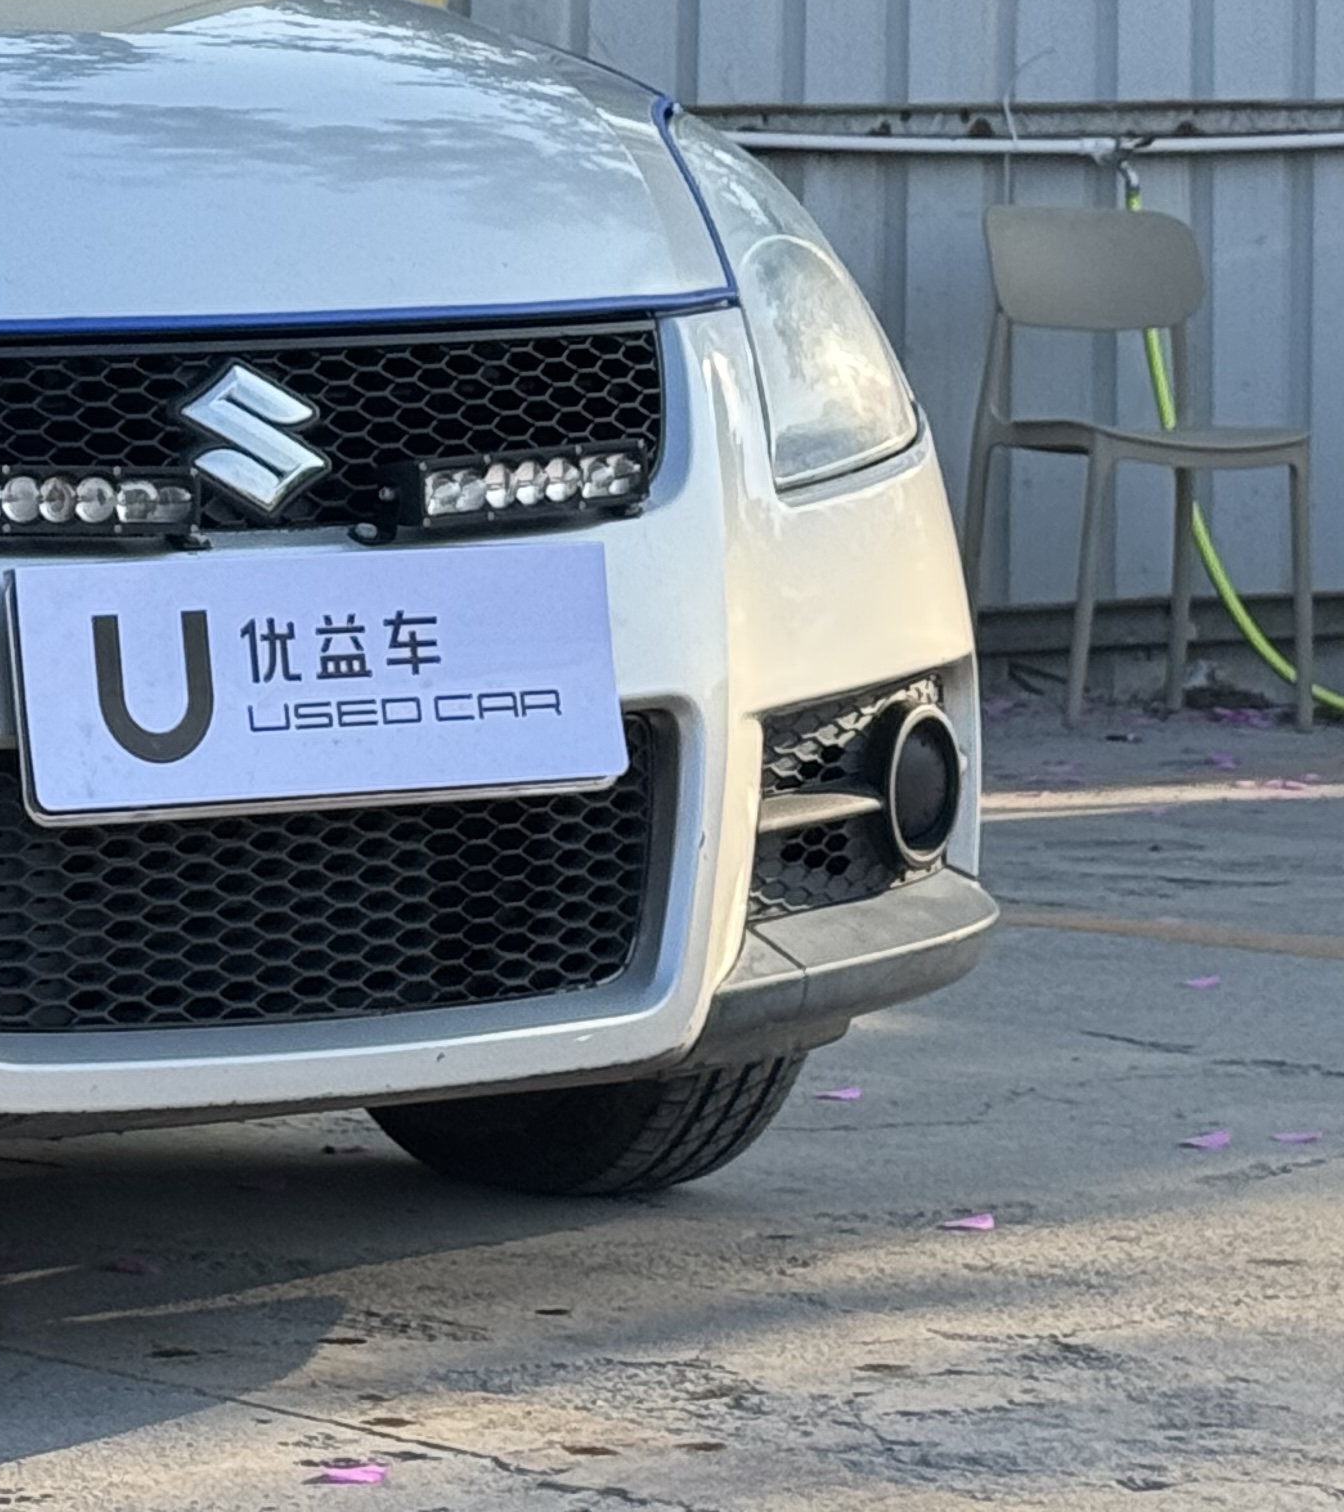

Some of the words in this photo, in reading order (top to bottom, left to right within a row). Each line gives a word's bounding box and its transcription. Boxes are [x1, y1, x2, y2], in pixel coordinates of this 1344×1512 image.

[240, 610, 441, 683] 优益车
[91, 609, 214, 763] U
[247, 697, 423, 732] USED
[434, 690, 562, 722] CAR
